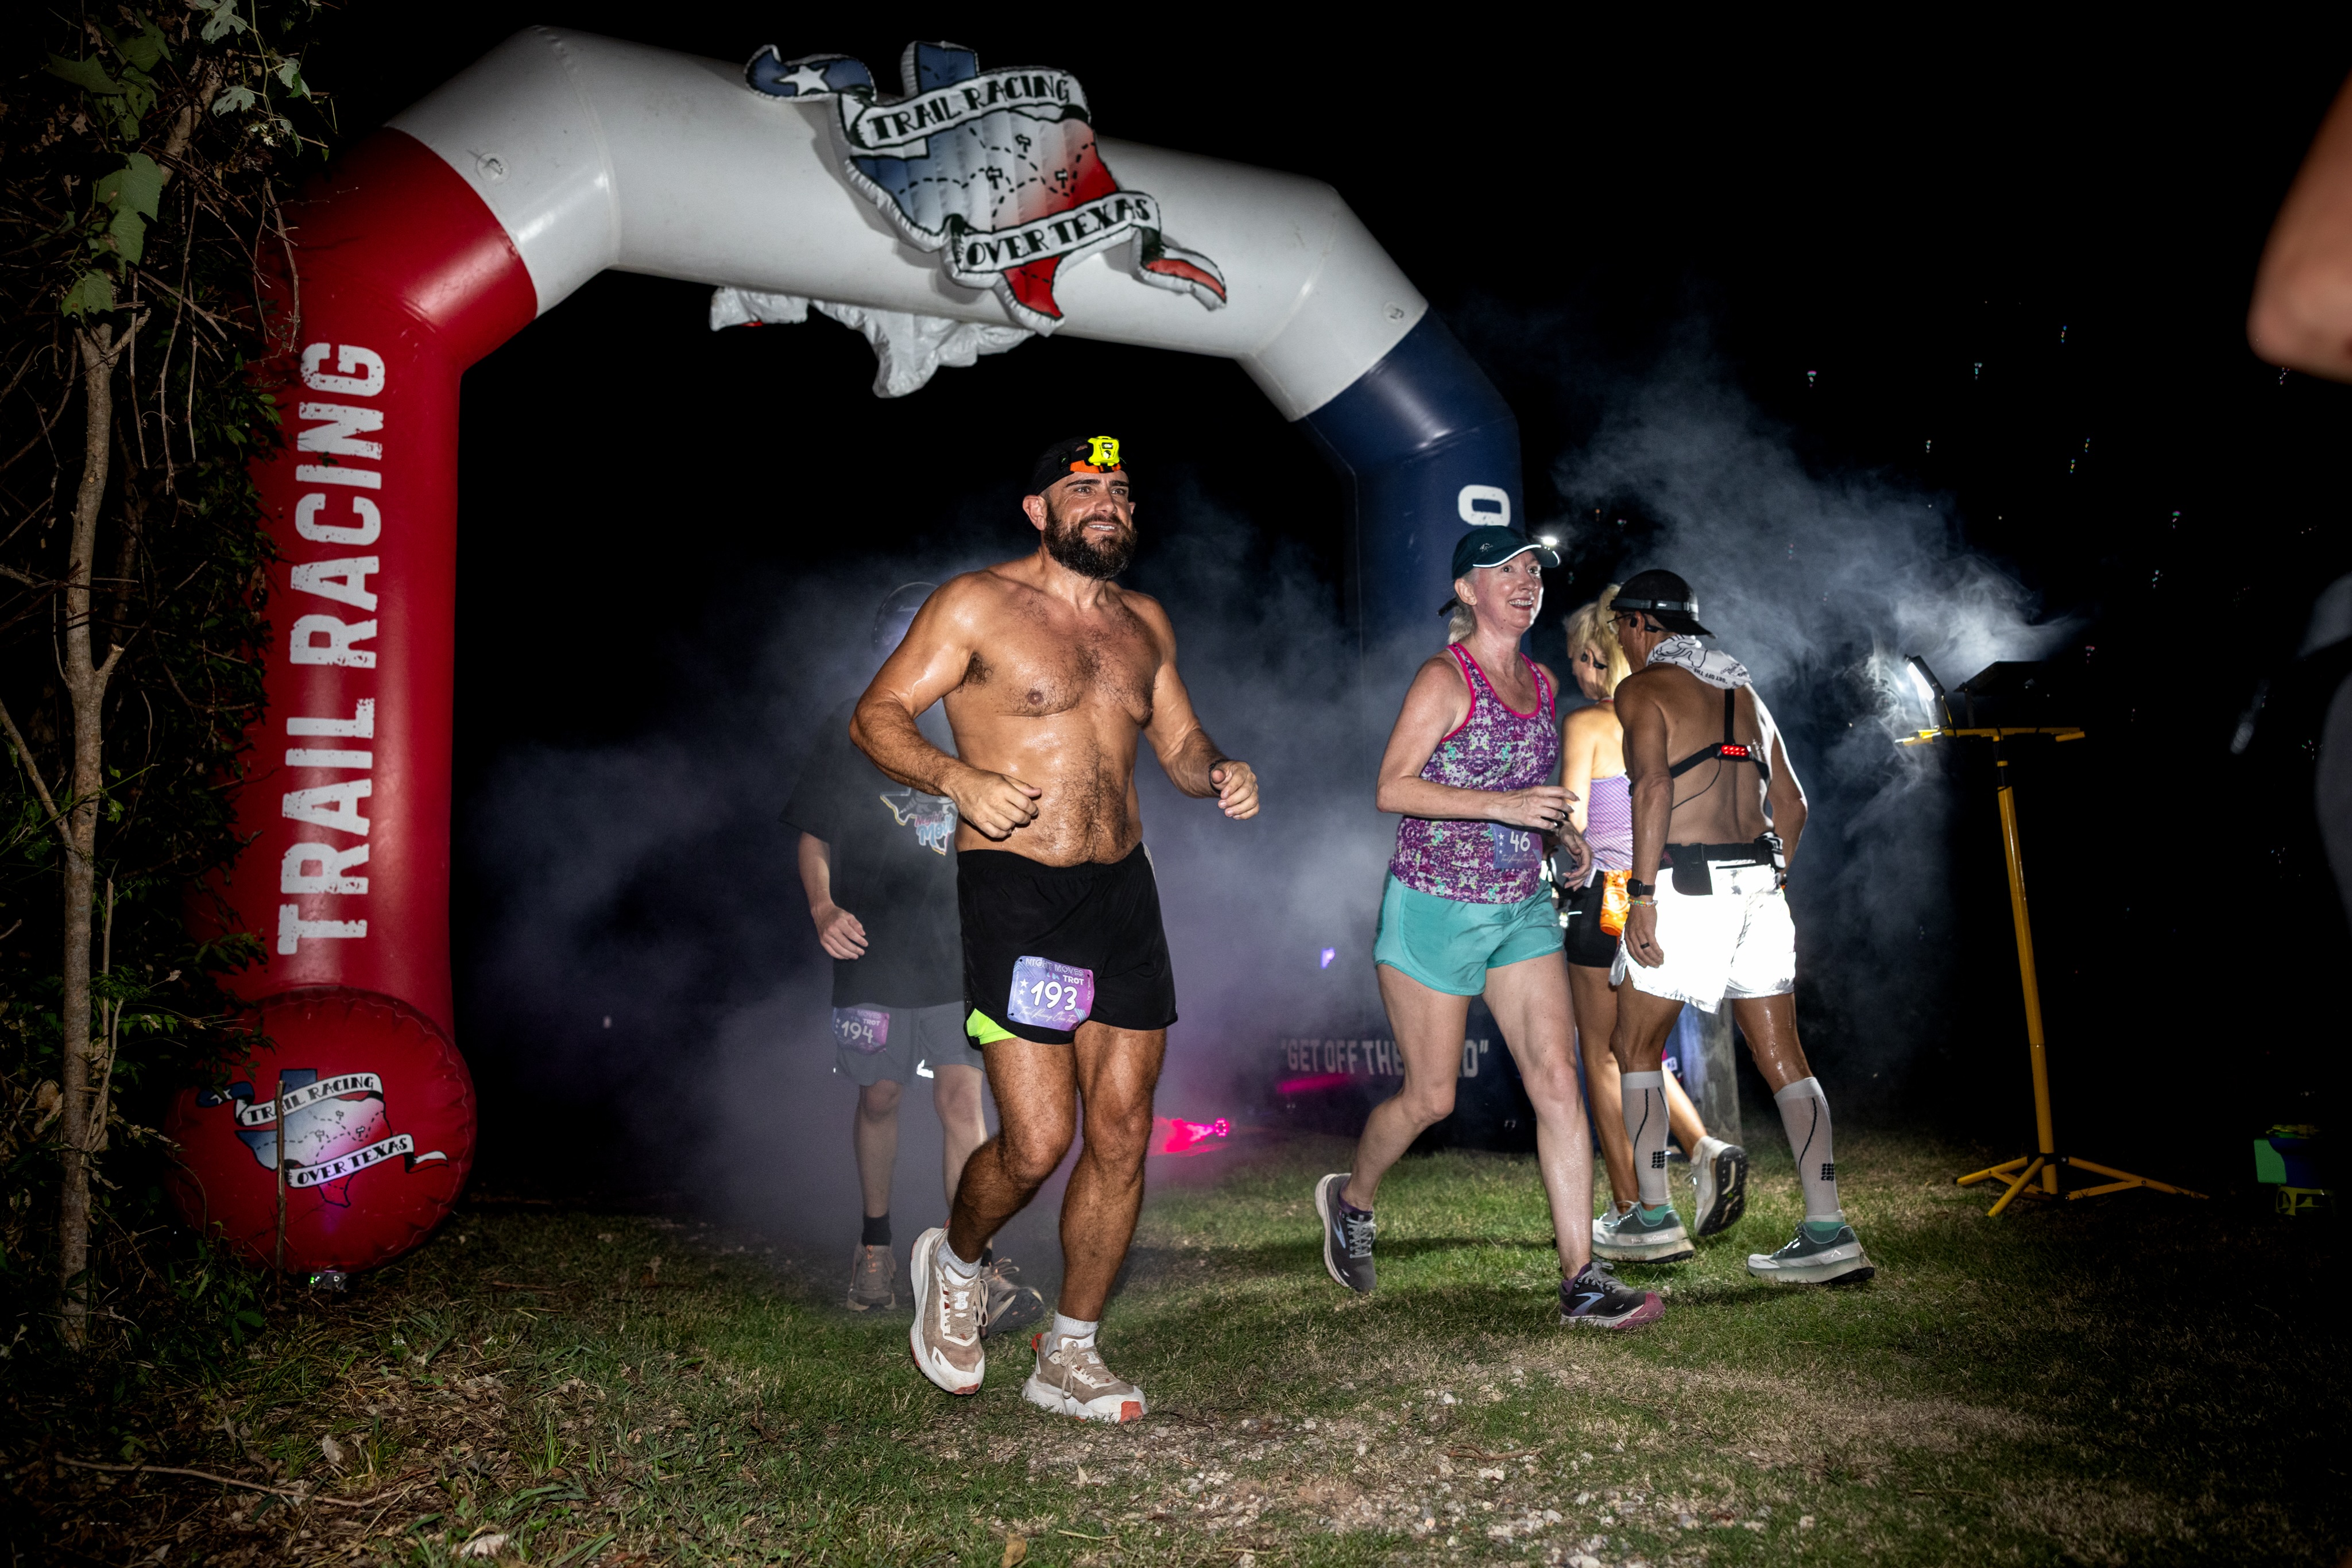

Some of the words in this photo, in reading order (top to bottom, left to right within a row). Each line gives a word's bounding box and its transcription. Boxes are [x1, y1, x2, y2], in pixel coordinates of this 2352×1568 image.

[867, 96, 962, 141] TRAIL
[961, 75, 1071, 111] RACING
[966, 229, 1050, 266] OVER
[1048, 198, 1151, 245] TEXAS
[289, 342, 385, 668] RACING
[277, 698, 374, 955] TRAIL
[1510, 831, 1530, 853] 46
[1026, 958, 1053, 970] NIGHT
[1054, 963, 1085, 978] MOVES
[1062, 974, 1085, 985] TROT
[1030, 979, 1078, 1011] 193
[841, 1020, 873, 1044] 194
[1324, 1039, 1357, 1074] OFF
[308, 1076, 374, 1099] RACING
[297, 1161, 347, 1185] OVER
[348, 1137, 408, 1168] TEXAS
